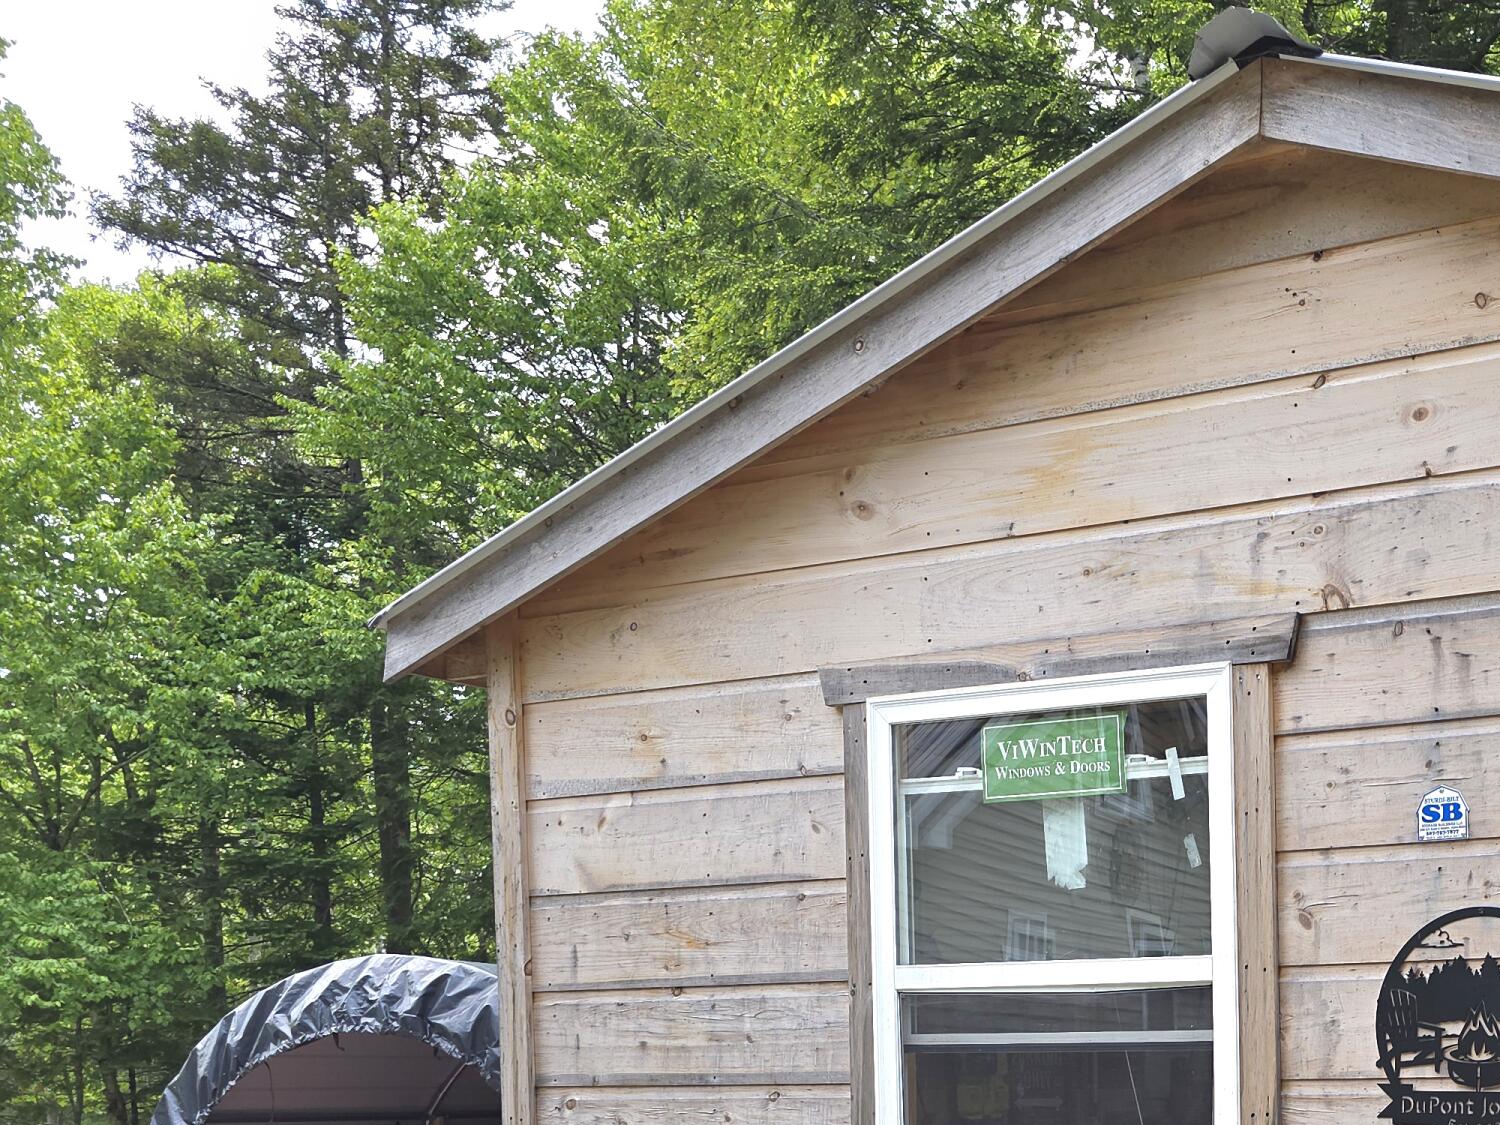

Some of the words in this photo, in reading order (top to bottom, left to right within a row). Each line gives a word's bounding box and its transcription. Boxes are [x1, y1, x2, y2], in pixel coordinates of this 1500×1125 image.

[995, 765, 1051, 780] WINDOWS
[1055, 761, 1066, 776] &
[1071, 760, 1111, 774] DOORS
[1421, 802, 1463, 823] SB
[1401, 1096, 1474, 1115] DuPont
